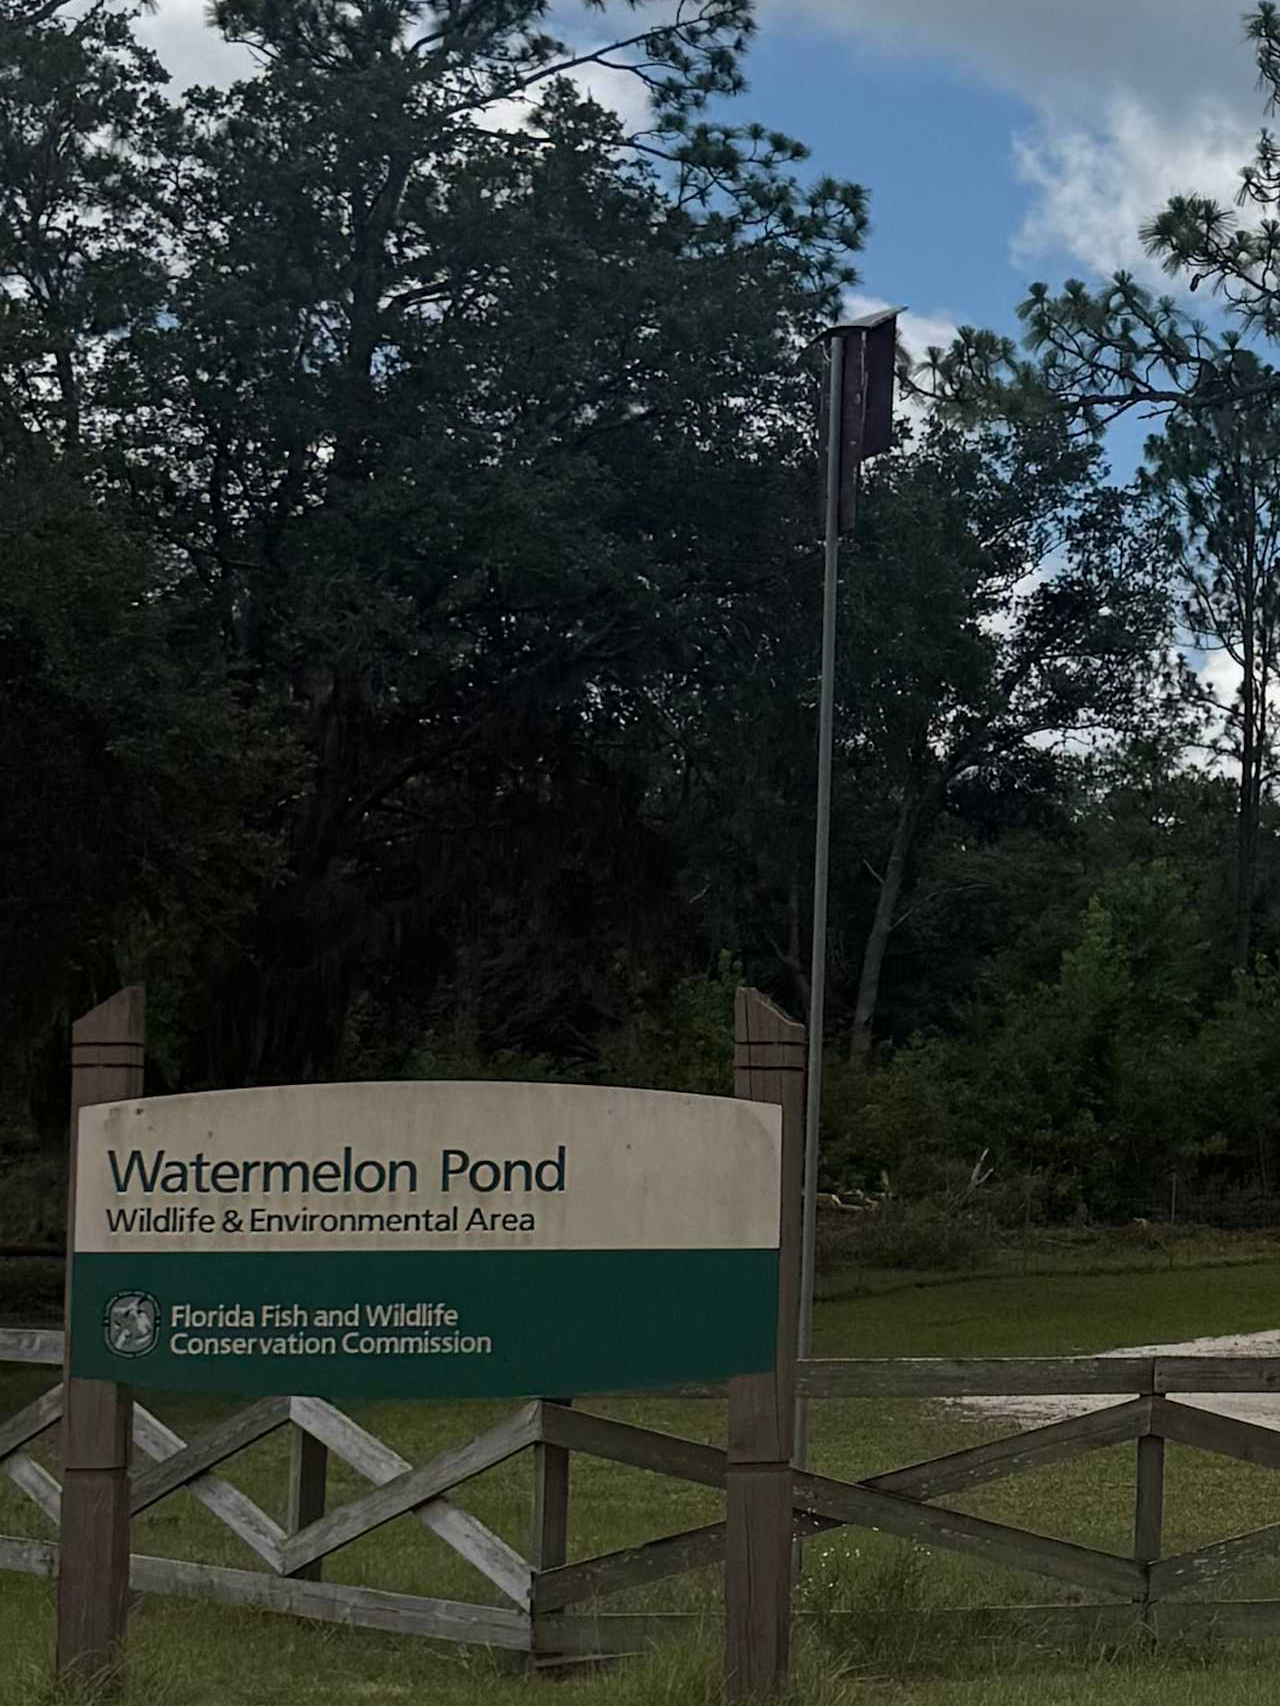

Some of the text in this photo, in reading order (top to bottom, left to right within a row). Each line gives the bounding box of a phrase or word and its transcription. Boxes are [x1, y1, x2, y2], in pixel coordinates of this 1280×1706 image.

[107, 1145, 566, 1193] Watermelon Pond
[106, 1206, 535, 1233] Wildlife & Environmental Area
[171, 1303, 459, 1328] Florida Fish and Wildlife
[170, 1330, 492, 1355] Conservation Commission
